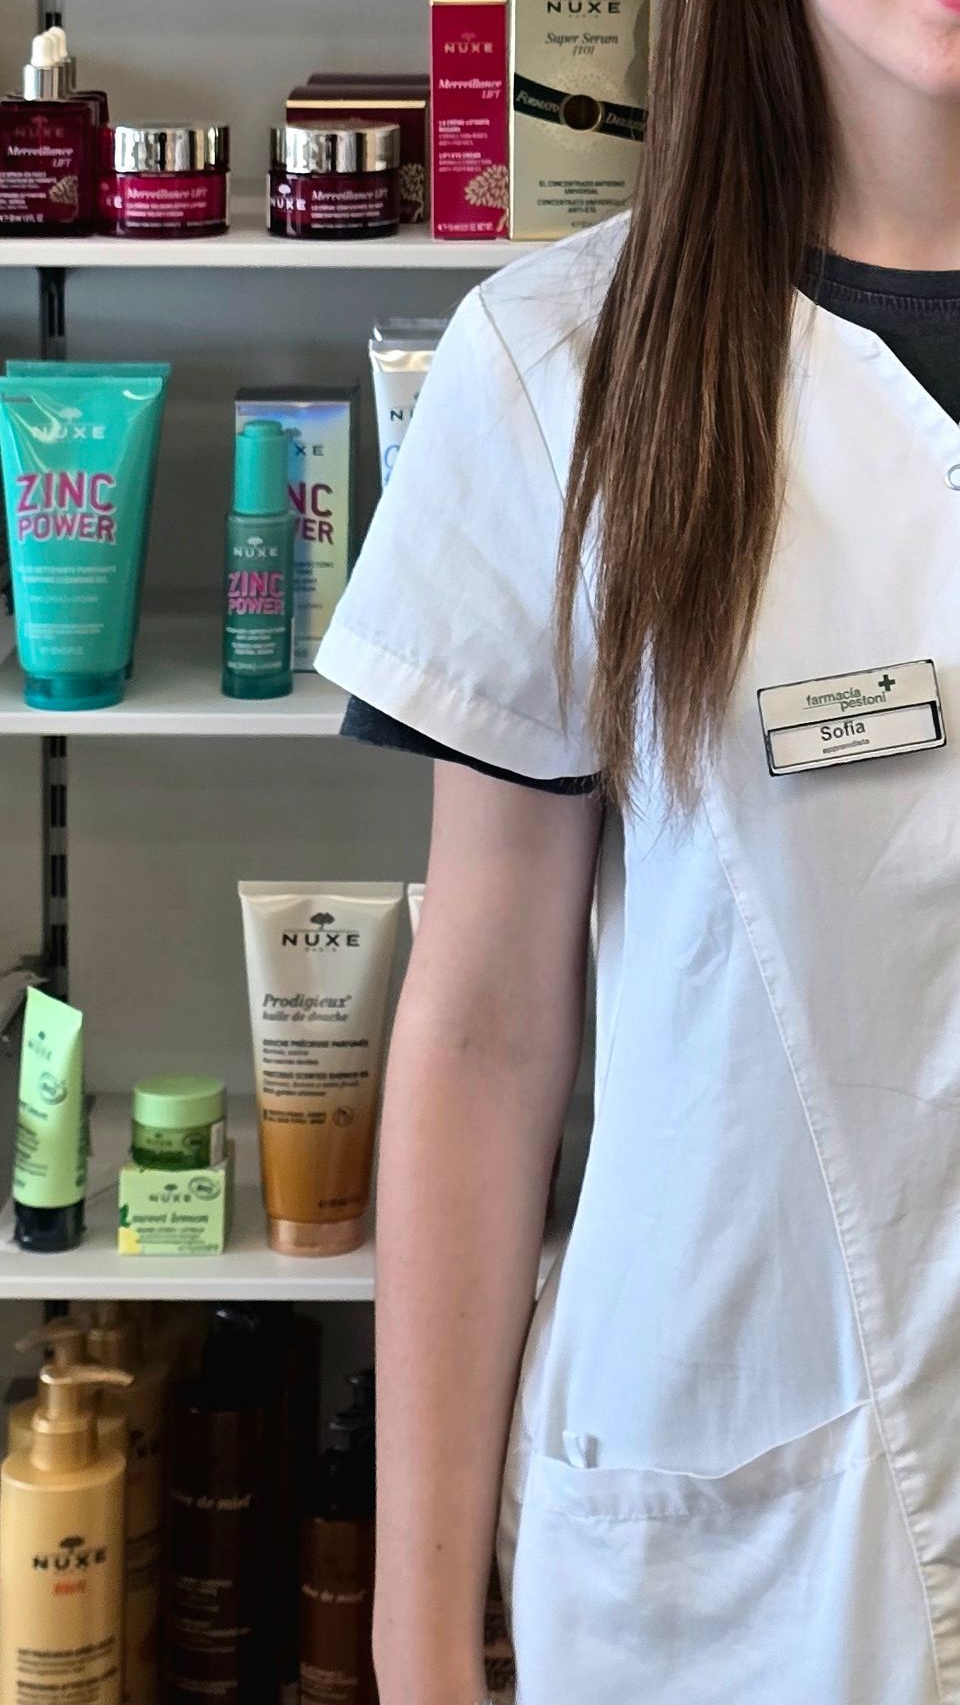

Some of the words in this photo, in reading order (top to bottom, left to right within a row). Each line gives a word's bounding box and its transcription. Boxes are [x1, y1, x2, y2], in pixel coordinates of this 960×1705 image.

[547, 2, 622, 14] NUXE
[545, 32, 579, 46] Super
[582, 32, 619, 45] Serum
[444, 43, 493, 54] NUXE
[439, 78, 502, 90] Merveillance
[482, 90, 501, 99] LIFT
[7, 146, 74, 157] Merveillance
[53, 158, 72, 168] LIFT
[32, 424, 105, 440] NUXE
[16, 471, 118, 513] ZINC
[17, 512, 118, 546] POWER
[233, 546, 278, 558] NUXE
[228, 571, 285, 598] ZINC
[228, 597, 285, 616] POWER
[806, 687, 862, 706] farmacia
[840, 691, 887, 713] pestoni
[820, 721, 866, 742] Sofia
[282, 934, 361, 947] NUXE
[262, 1011, 289, 1022] huile
[291, 1012, 306, 1022] de
[307, 1011, 350, 1022] douche
[32, 1551, 107, 1572] NUXE
